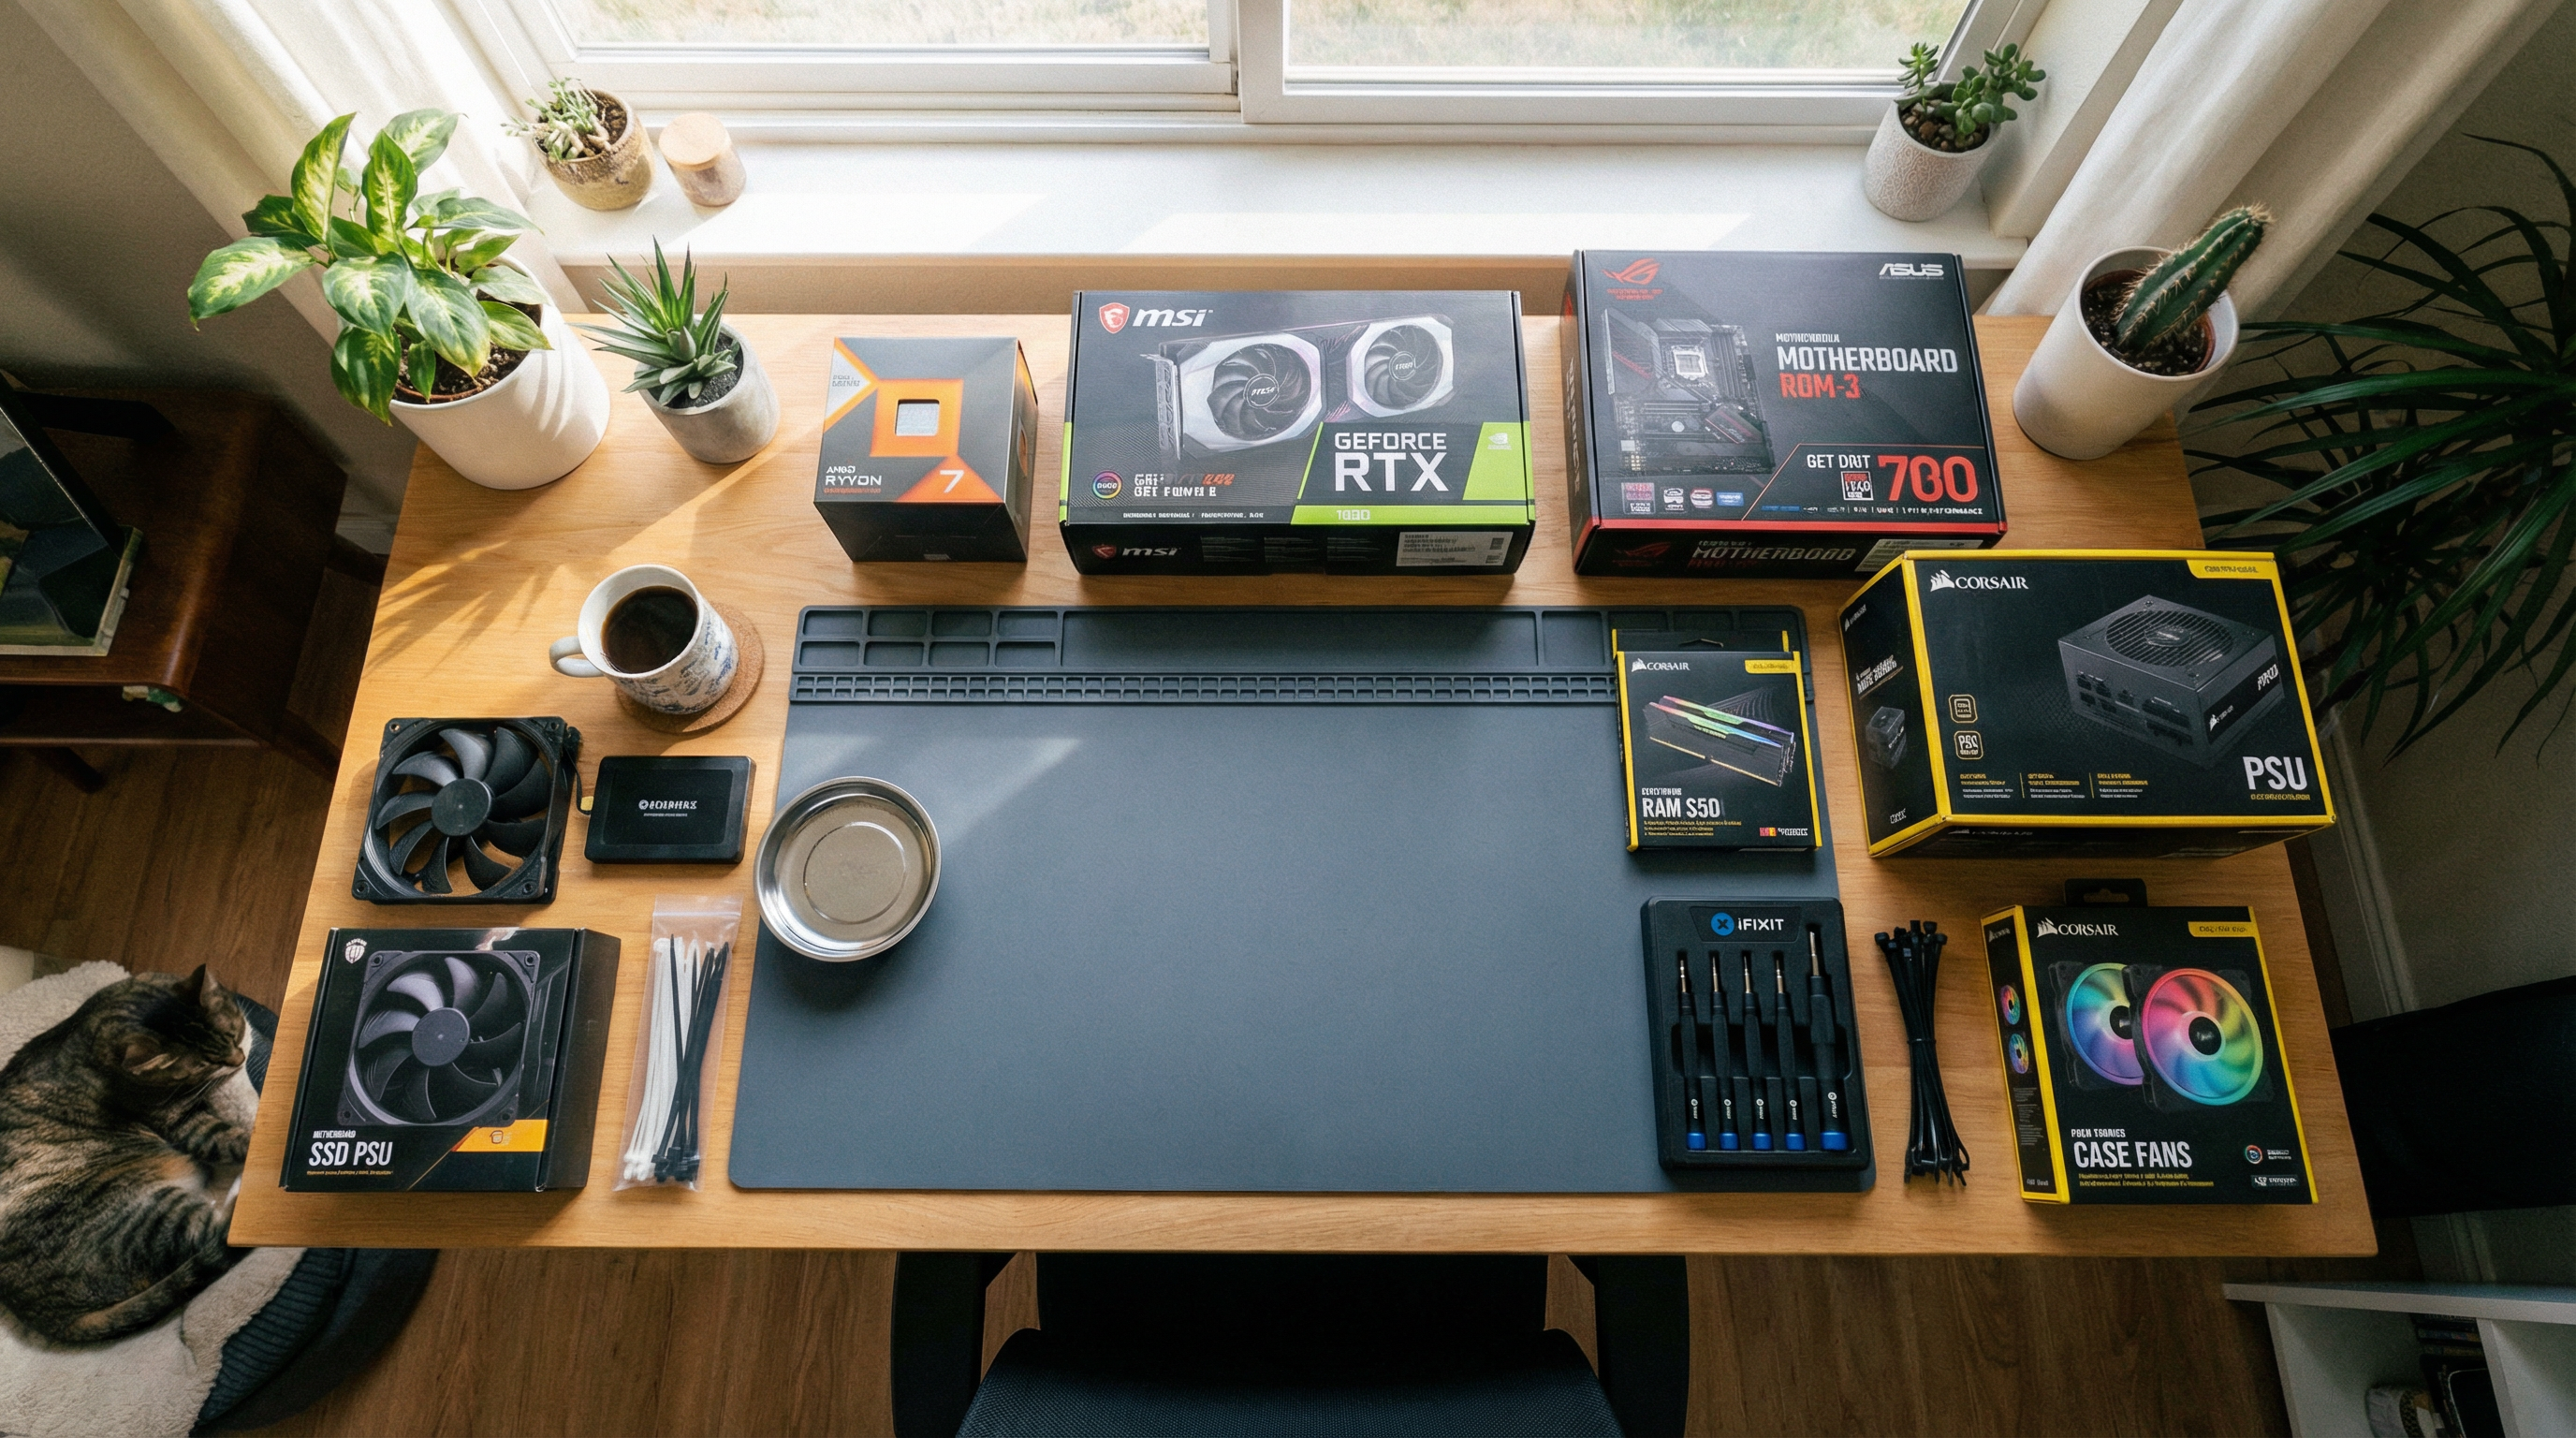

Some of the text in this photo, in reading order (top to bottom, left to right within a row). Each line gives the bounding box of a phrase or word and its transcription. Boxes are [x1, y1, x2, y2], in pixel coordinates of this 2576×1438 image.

[1879, 263, 1944, 276] ASUS
[1132, 309, 1208, 327] msi
[1777, 346, 1958, 373] MOTHERBOARD
[1334, 432, 1447, 450] GEFORCE
[1807, 454, 1835, 468] GET
[939, 469, 964, 493] 7
[1335, 452, 1449, 492] RTX
[1122, 547, 1178, 556] msi
[1954, 576, 2029, 590] CORSAIR
[2242, 756, 2308, 791] PSU
[1642, 797, 1720, 818] RAM S50
[2057, 923, 2119, 936] CORSAIR
[308, 1140, 393, 1167] SSD PSU
[2073, 1140, 2193, 1168] CASE FANS
